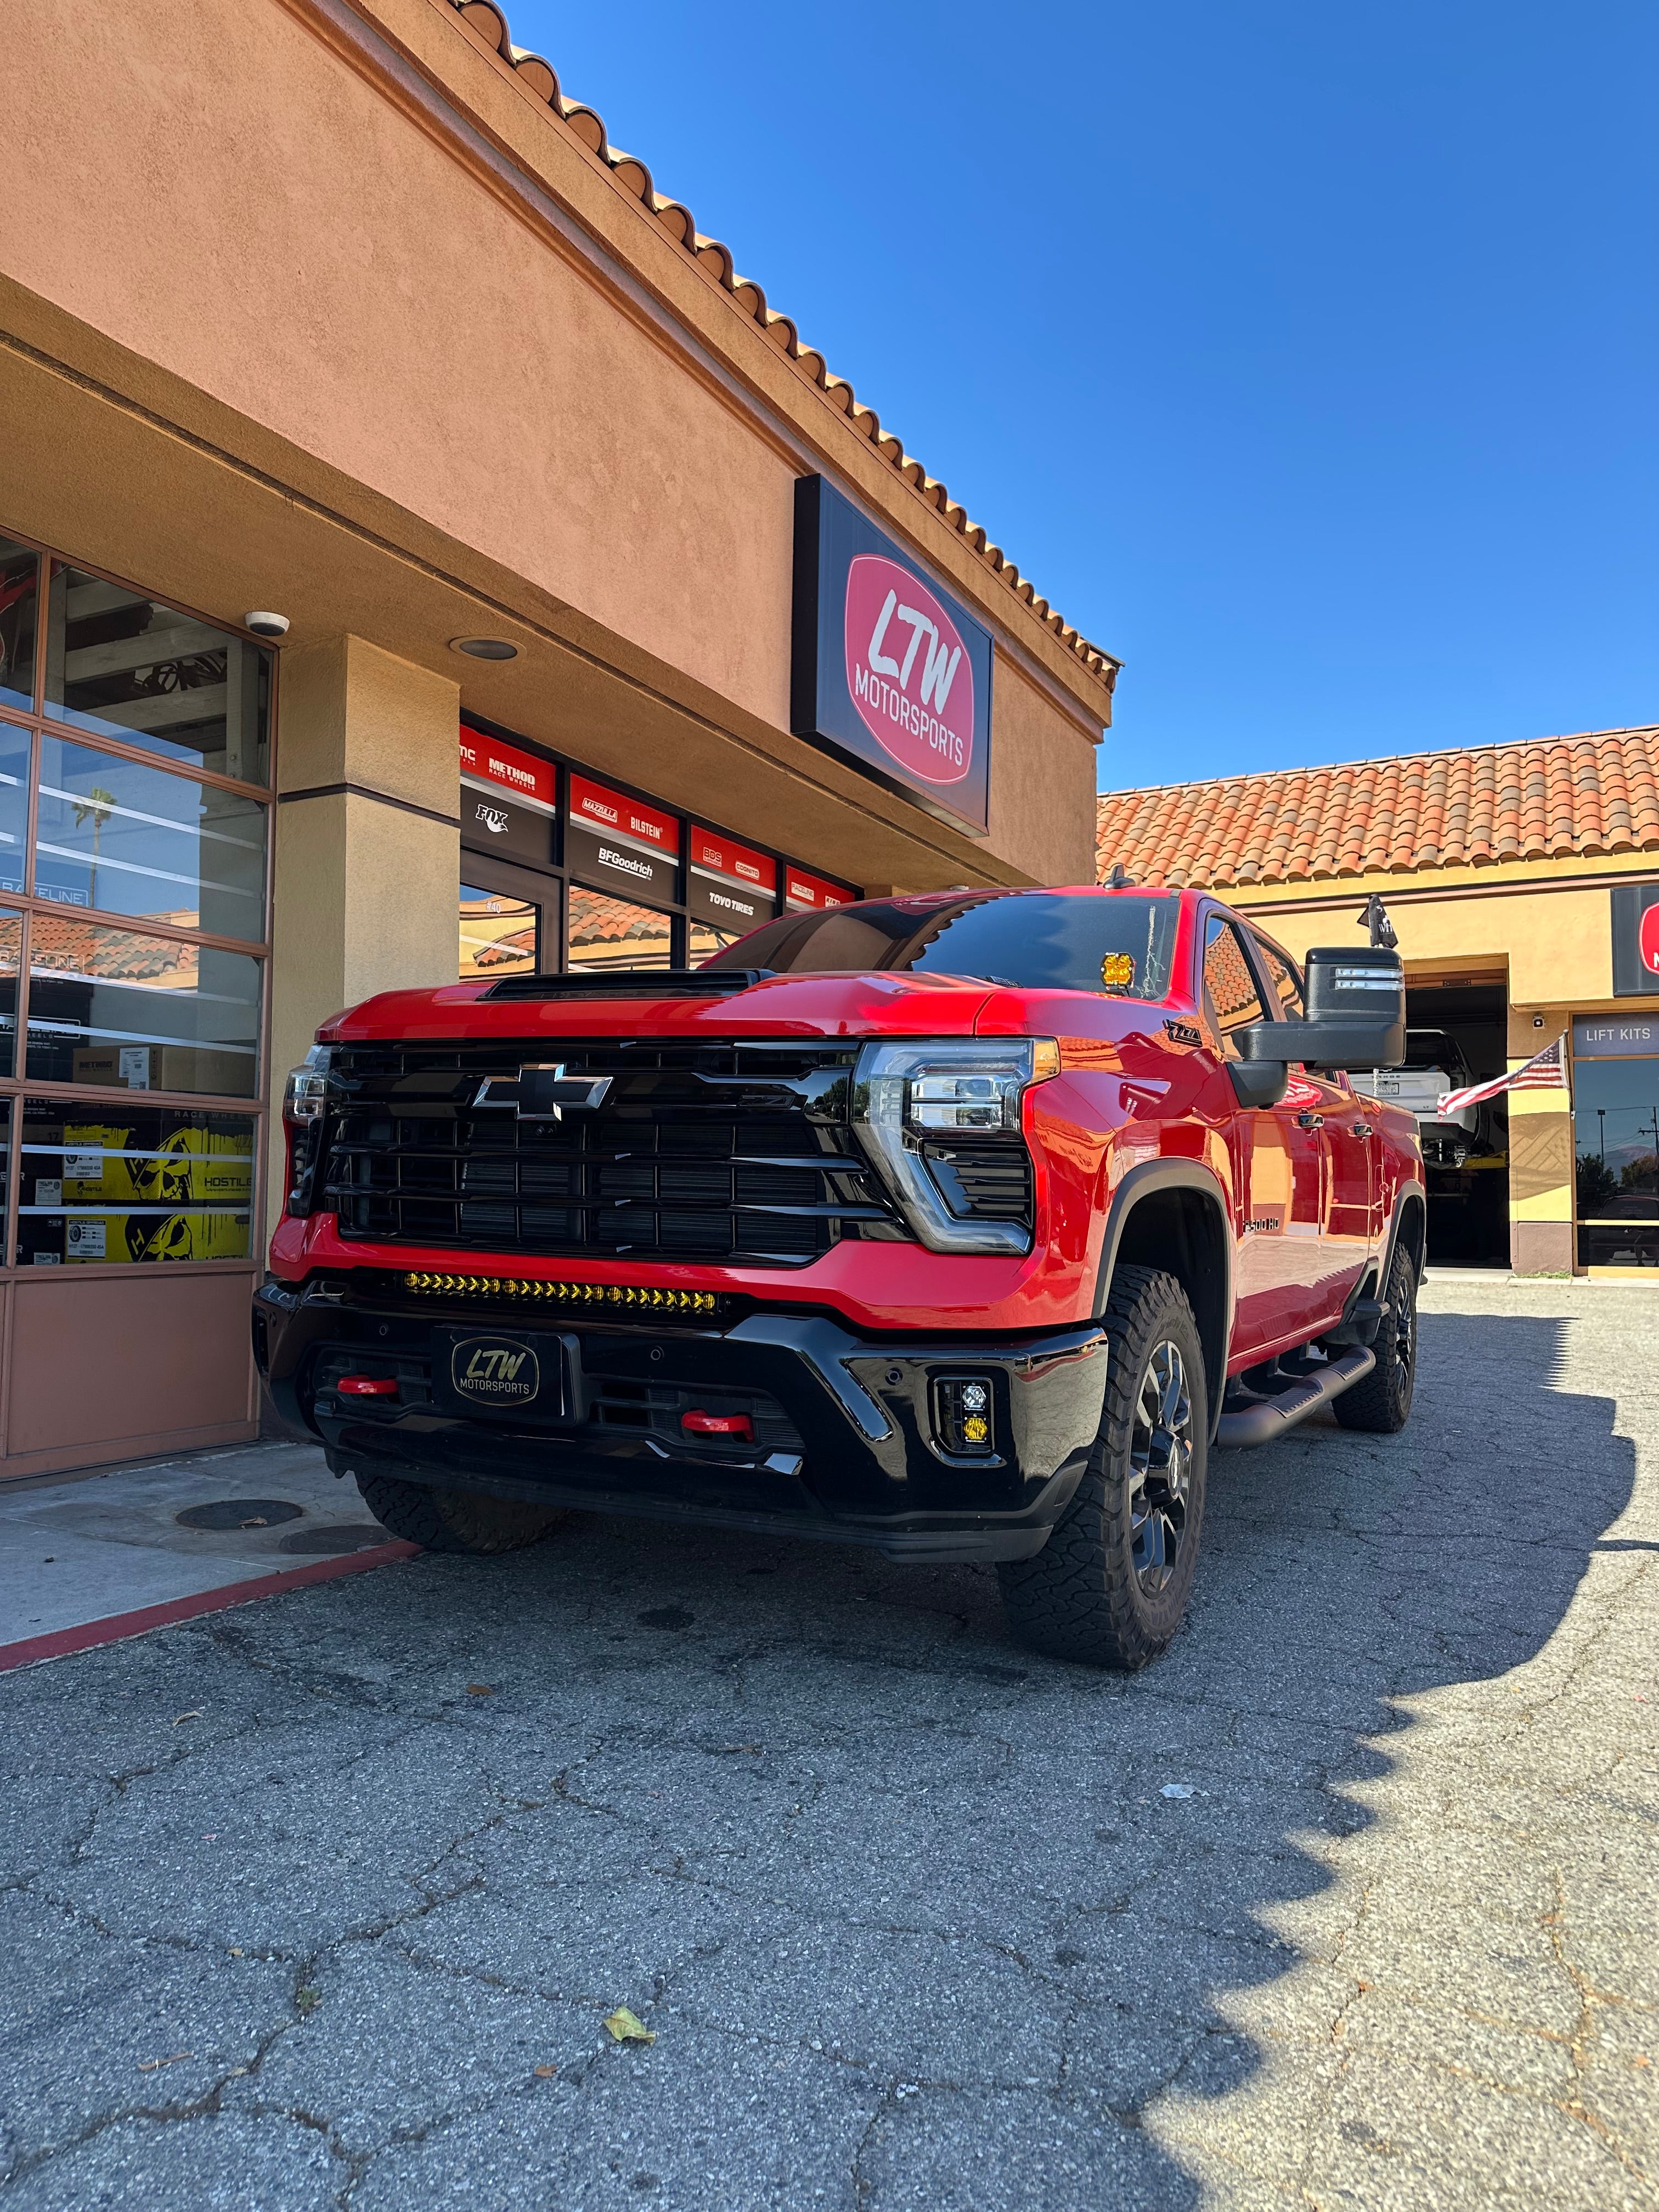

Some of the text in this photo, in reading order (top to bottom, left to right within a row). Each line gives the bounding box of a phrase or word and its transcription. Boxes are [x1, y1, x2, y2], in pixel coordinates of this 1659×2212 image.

[868, 589, 961, 715] LTW
[855, 663, 963, 766] MOTORSPORTS
[489, 758, 535, 785] METHOD
[489, 769, 535, 791] RACE WHEELS
[476, 804, 508, 826] FOX
[584, 800, 616, 819] MAZZULLA
[631, 816, 660, 839] BILSTEIN
[599, 847, 653, 877] BFGoodrich
[704, 849, 721, 862] BDS
[736, 864, 758, 876] COGNITO
[2, 882, 83, 905] RAELINE
[792, 883, 814, 898] RACELINE
[486, 901, 500, 913] #40
[709, 892, 754, 916] TOYO TIRES
[1586, 1028, 1651, 1041] LIFT KITS
[205, 1177, 251, 1187] HOSTILE
[466, 1348, 526, 1380] LTW
[460, 1378, 529, 1395] MOTORSPORTS
